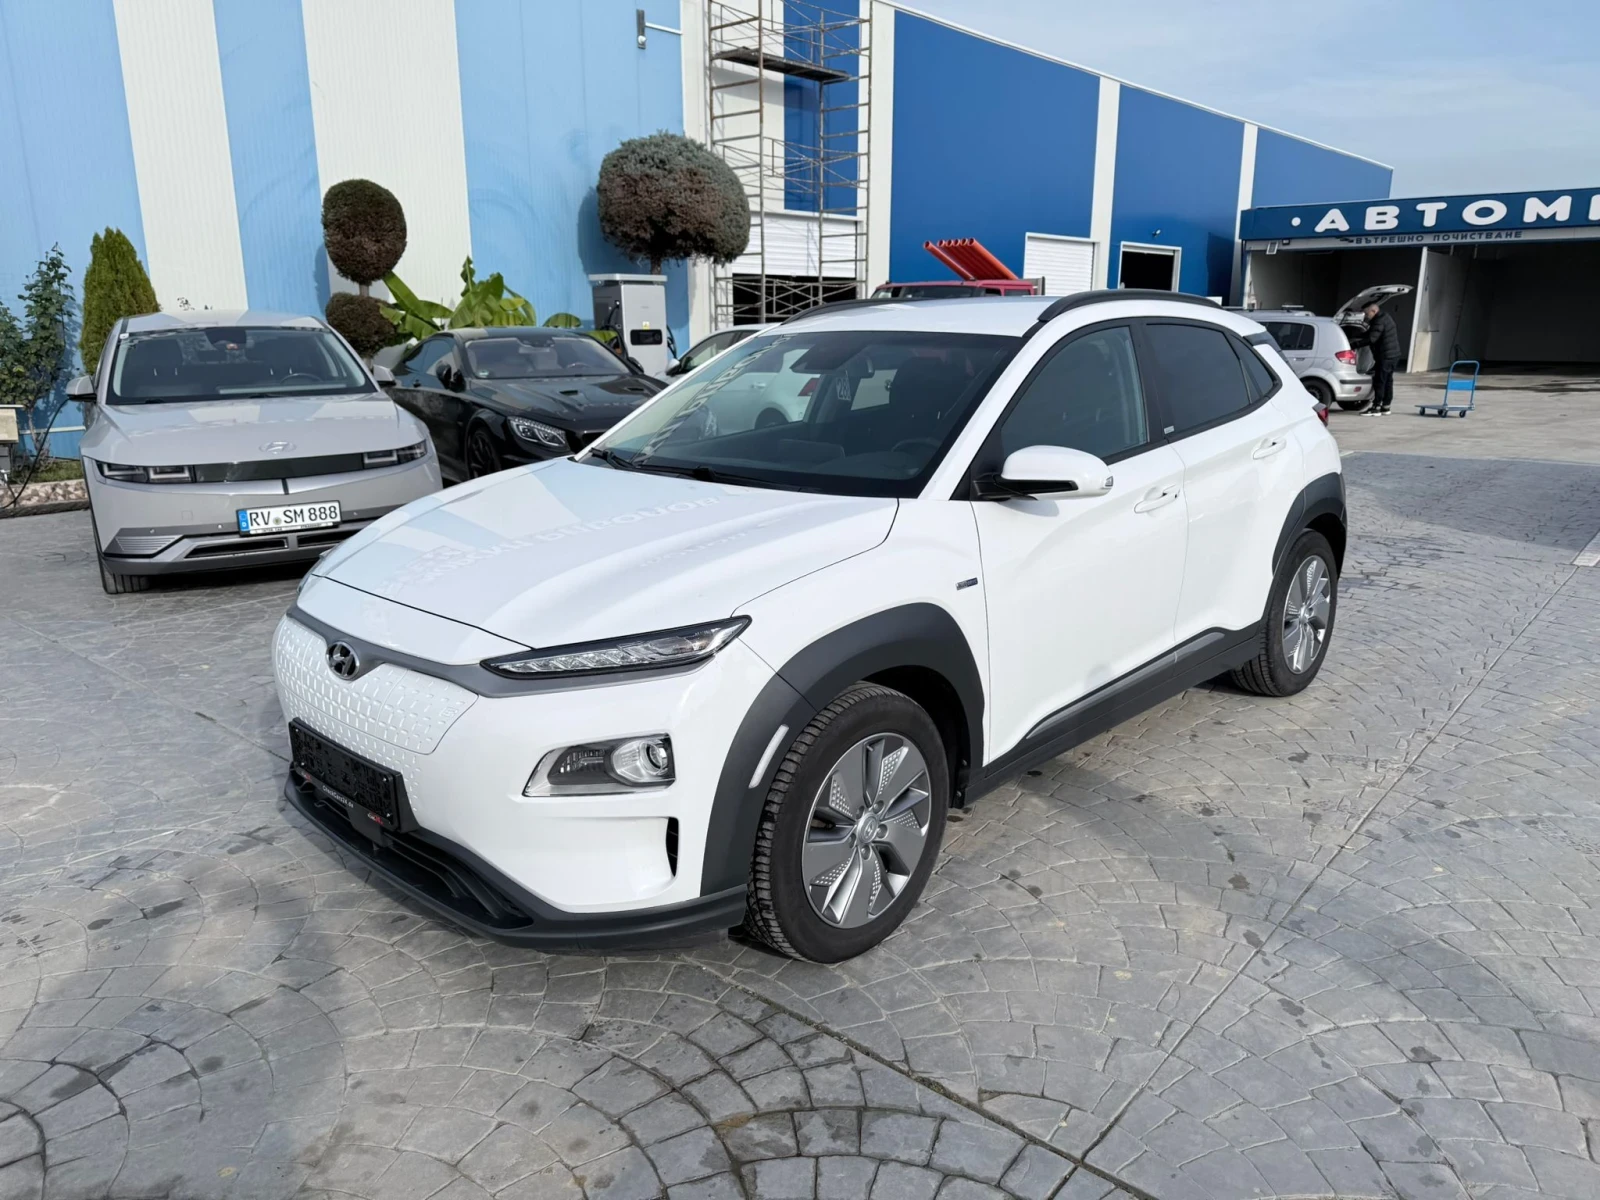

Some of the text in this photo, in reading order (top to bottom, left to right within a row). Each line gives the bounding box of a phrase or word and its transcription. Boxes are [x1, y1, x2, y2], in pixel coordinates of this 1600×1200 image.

[1356, 231, 1523, 244] ВЪТРЕШНО ПОЧИСТВАНЕ
[249, 505, 338, 527] RV SM 888
